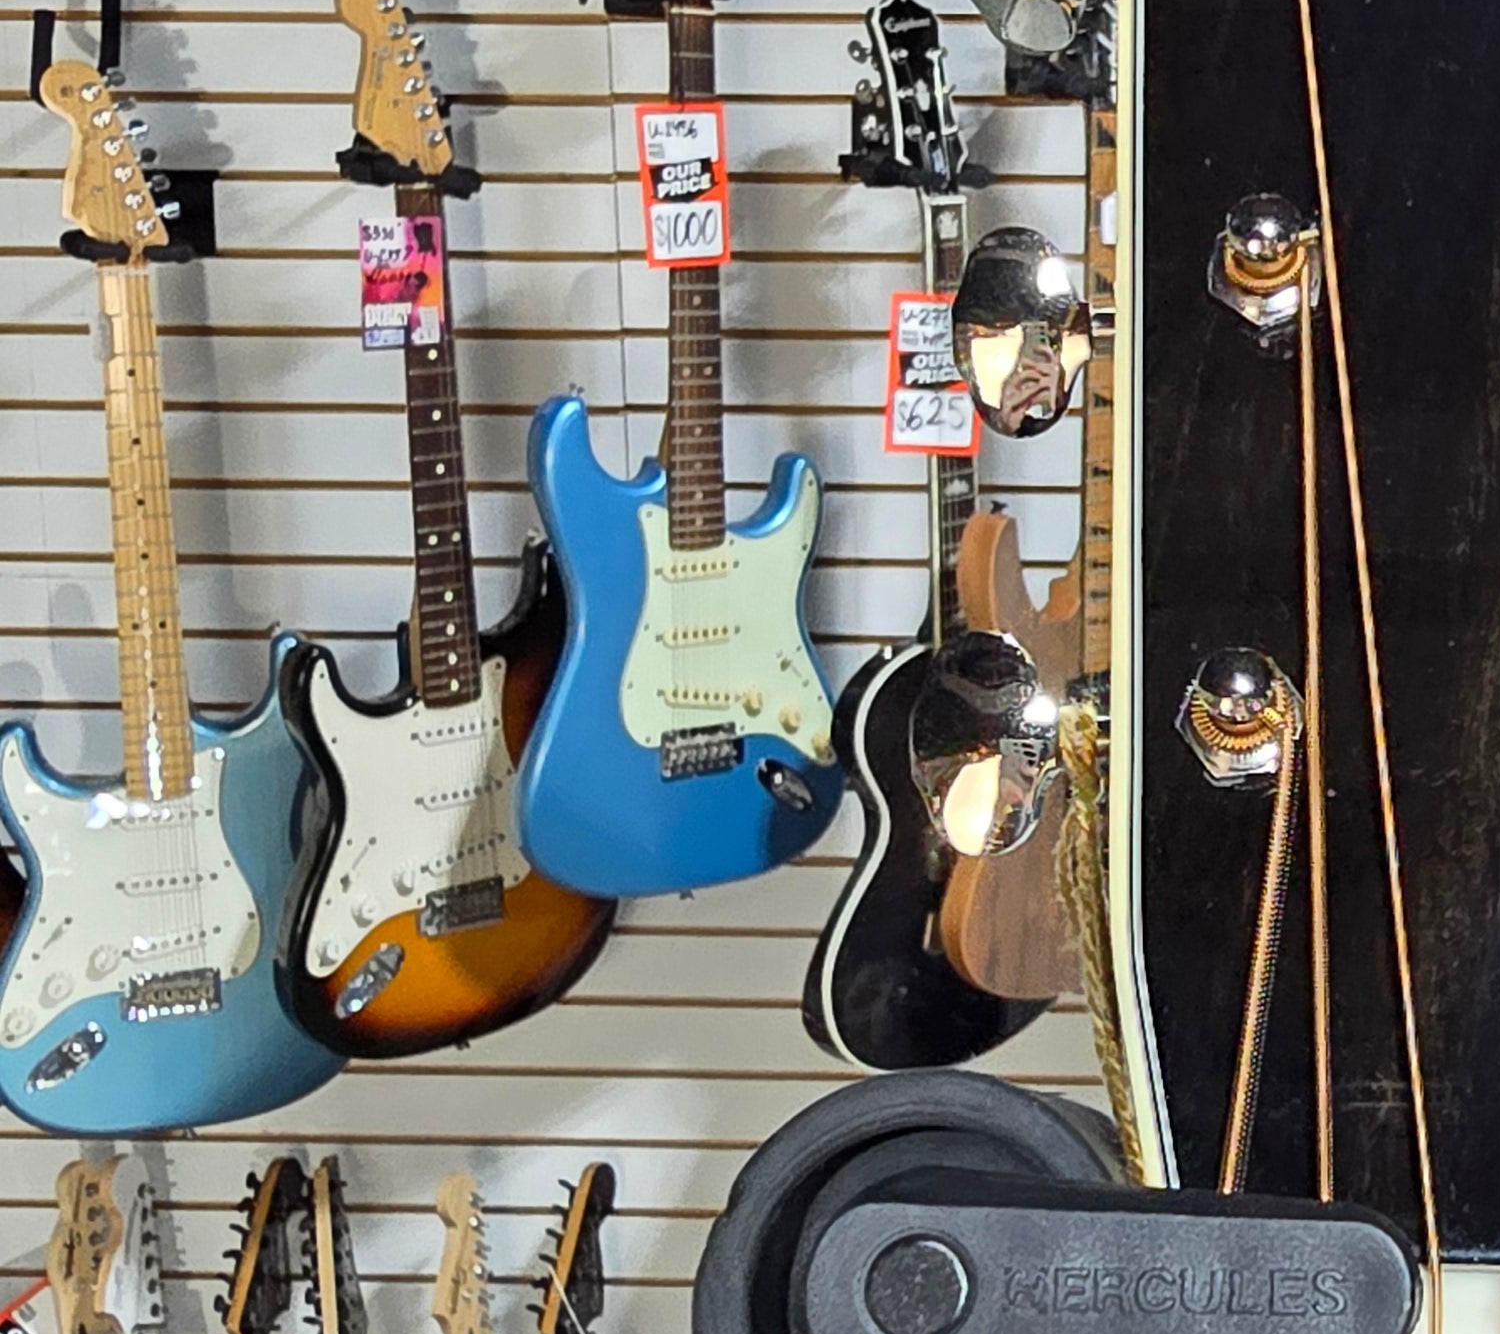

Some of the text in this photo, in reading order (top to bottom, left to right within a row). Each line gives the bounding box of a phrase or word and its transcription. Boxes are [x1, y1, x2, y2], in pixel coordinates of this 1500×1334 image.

[656, 172, 712, 199] PRICE
[661, 160, 702, 181] OUR
[653, 207, 719, 254] $1000
[897, 395, 966, 433] $625
[1002, 1266, 1349, 1318] HERCULES
